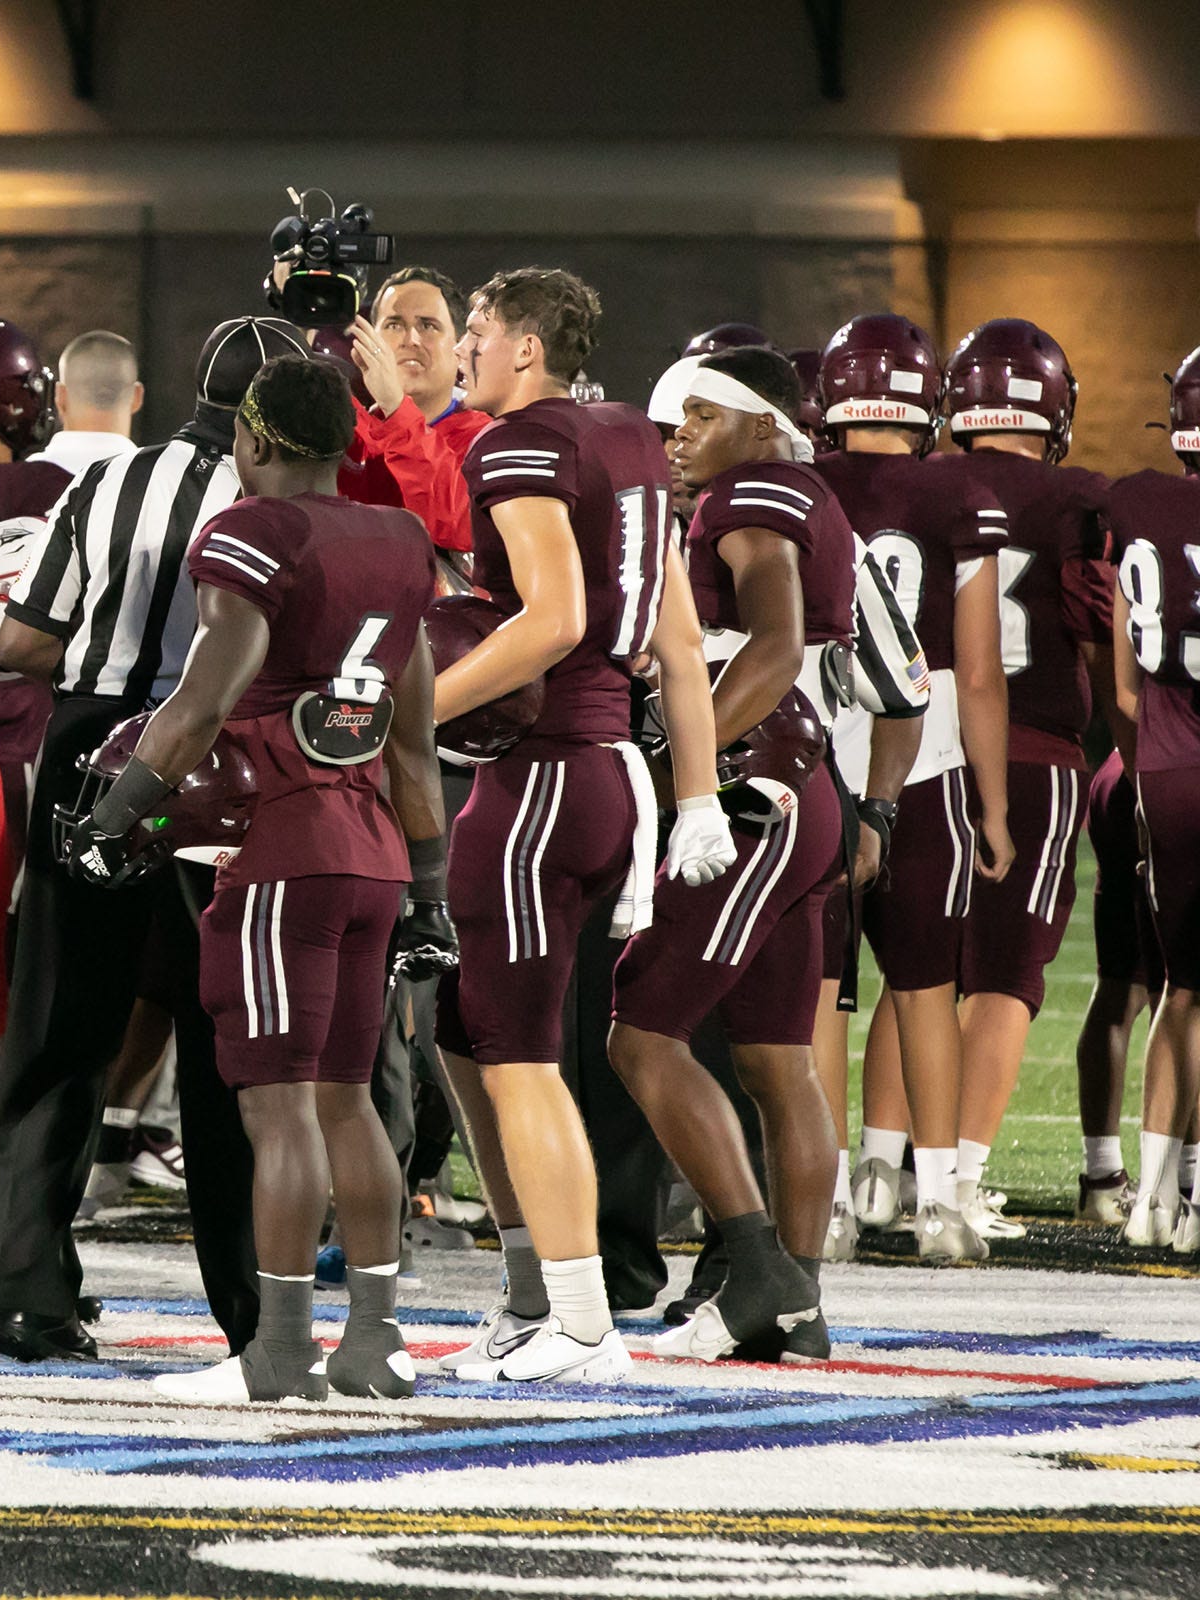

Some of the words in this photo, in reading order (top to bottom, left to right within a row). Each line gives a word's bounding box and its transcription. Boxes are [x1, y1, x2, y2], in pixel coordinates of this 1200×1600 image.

[843, 405, 907, 420] Riddell
[962, 413, 1024, 428] Riddell
[330, 612, 393, 704] 6
